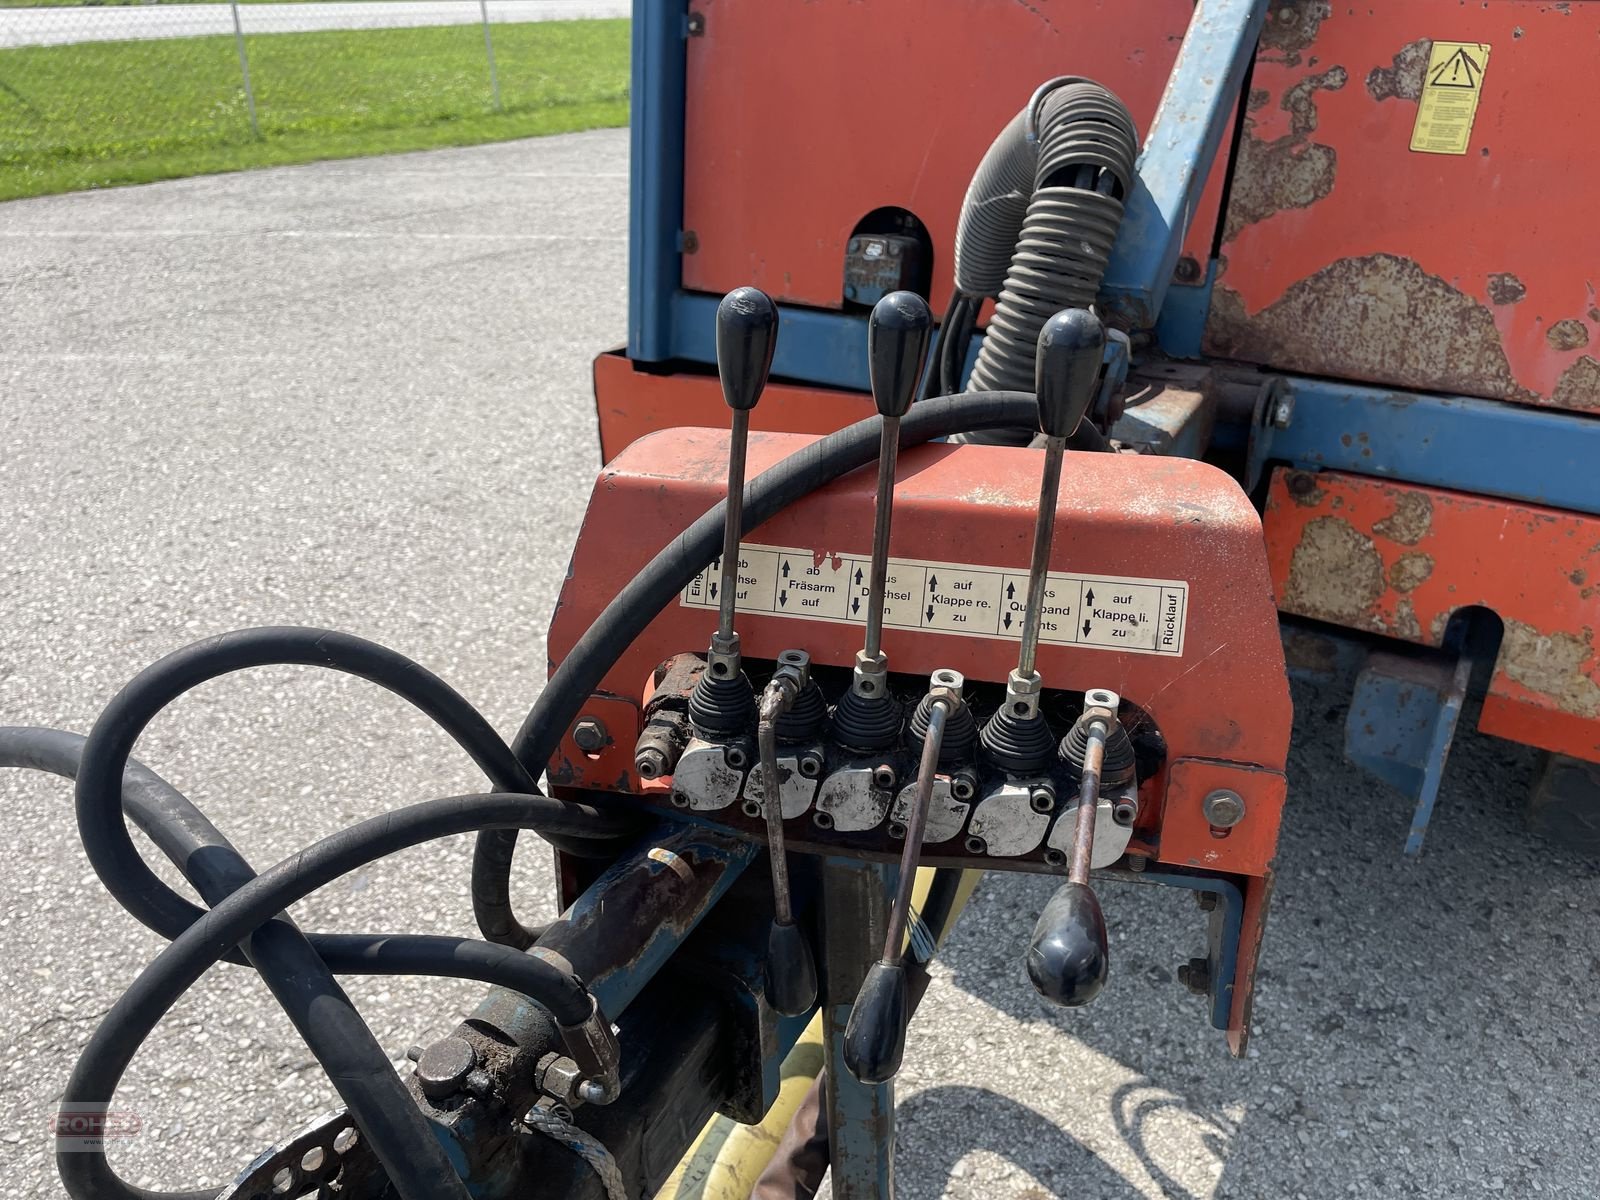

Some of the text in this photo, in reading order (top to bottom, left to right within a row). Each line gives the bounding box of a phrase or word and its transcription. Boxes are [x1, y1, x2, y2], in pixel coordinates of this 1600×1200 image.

[806, 566, 821, 576] ab
[788, 579, 835, 593] Fräsarm
[953, 581, 973, 591] auf
[801, 598, 821, 607] auf
[931, 594, 991, 609] Klappe re.
[1112, 594, 1133, 604] auf
[952, 614, 967, 622] zu
[1092, 608, 1149, 623] Klappe li.
[1162, 593, 1177, 646] Rücklauf
[1111, 628, 1127, 637] zu
